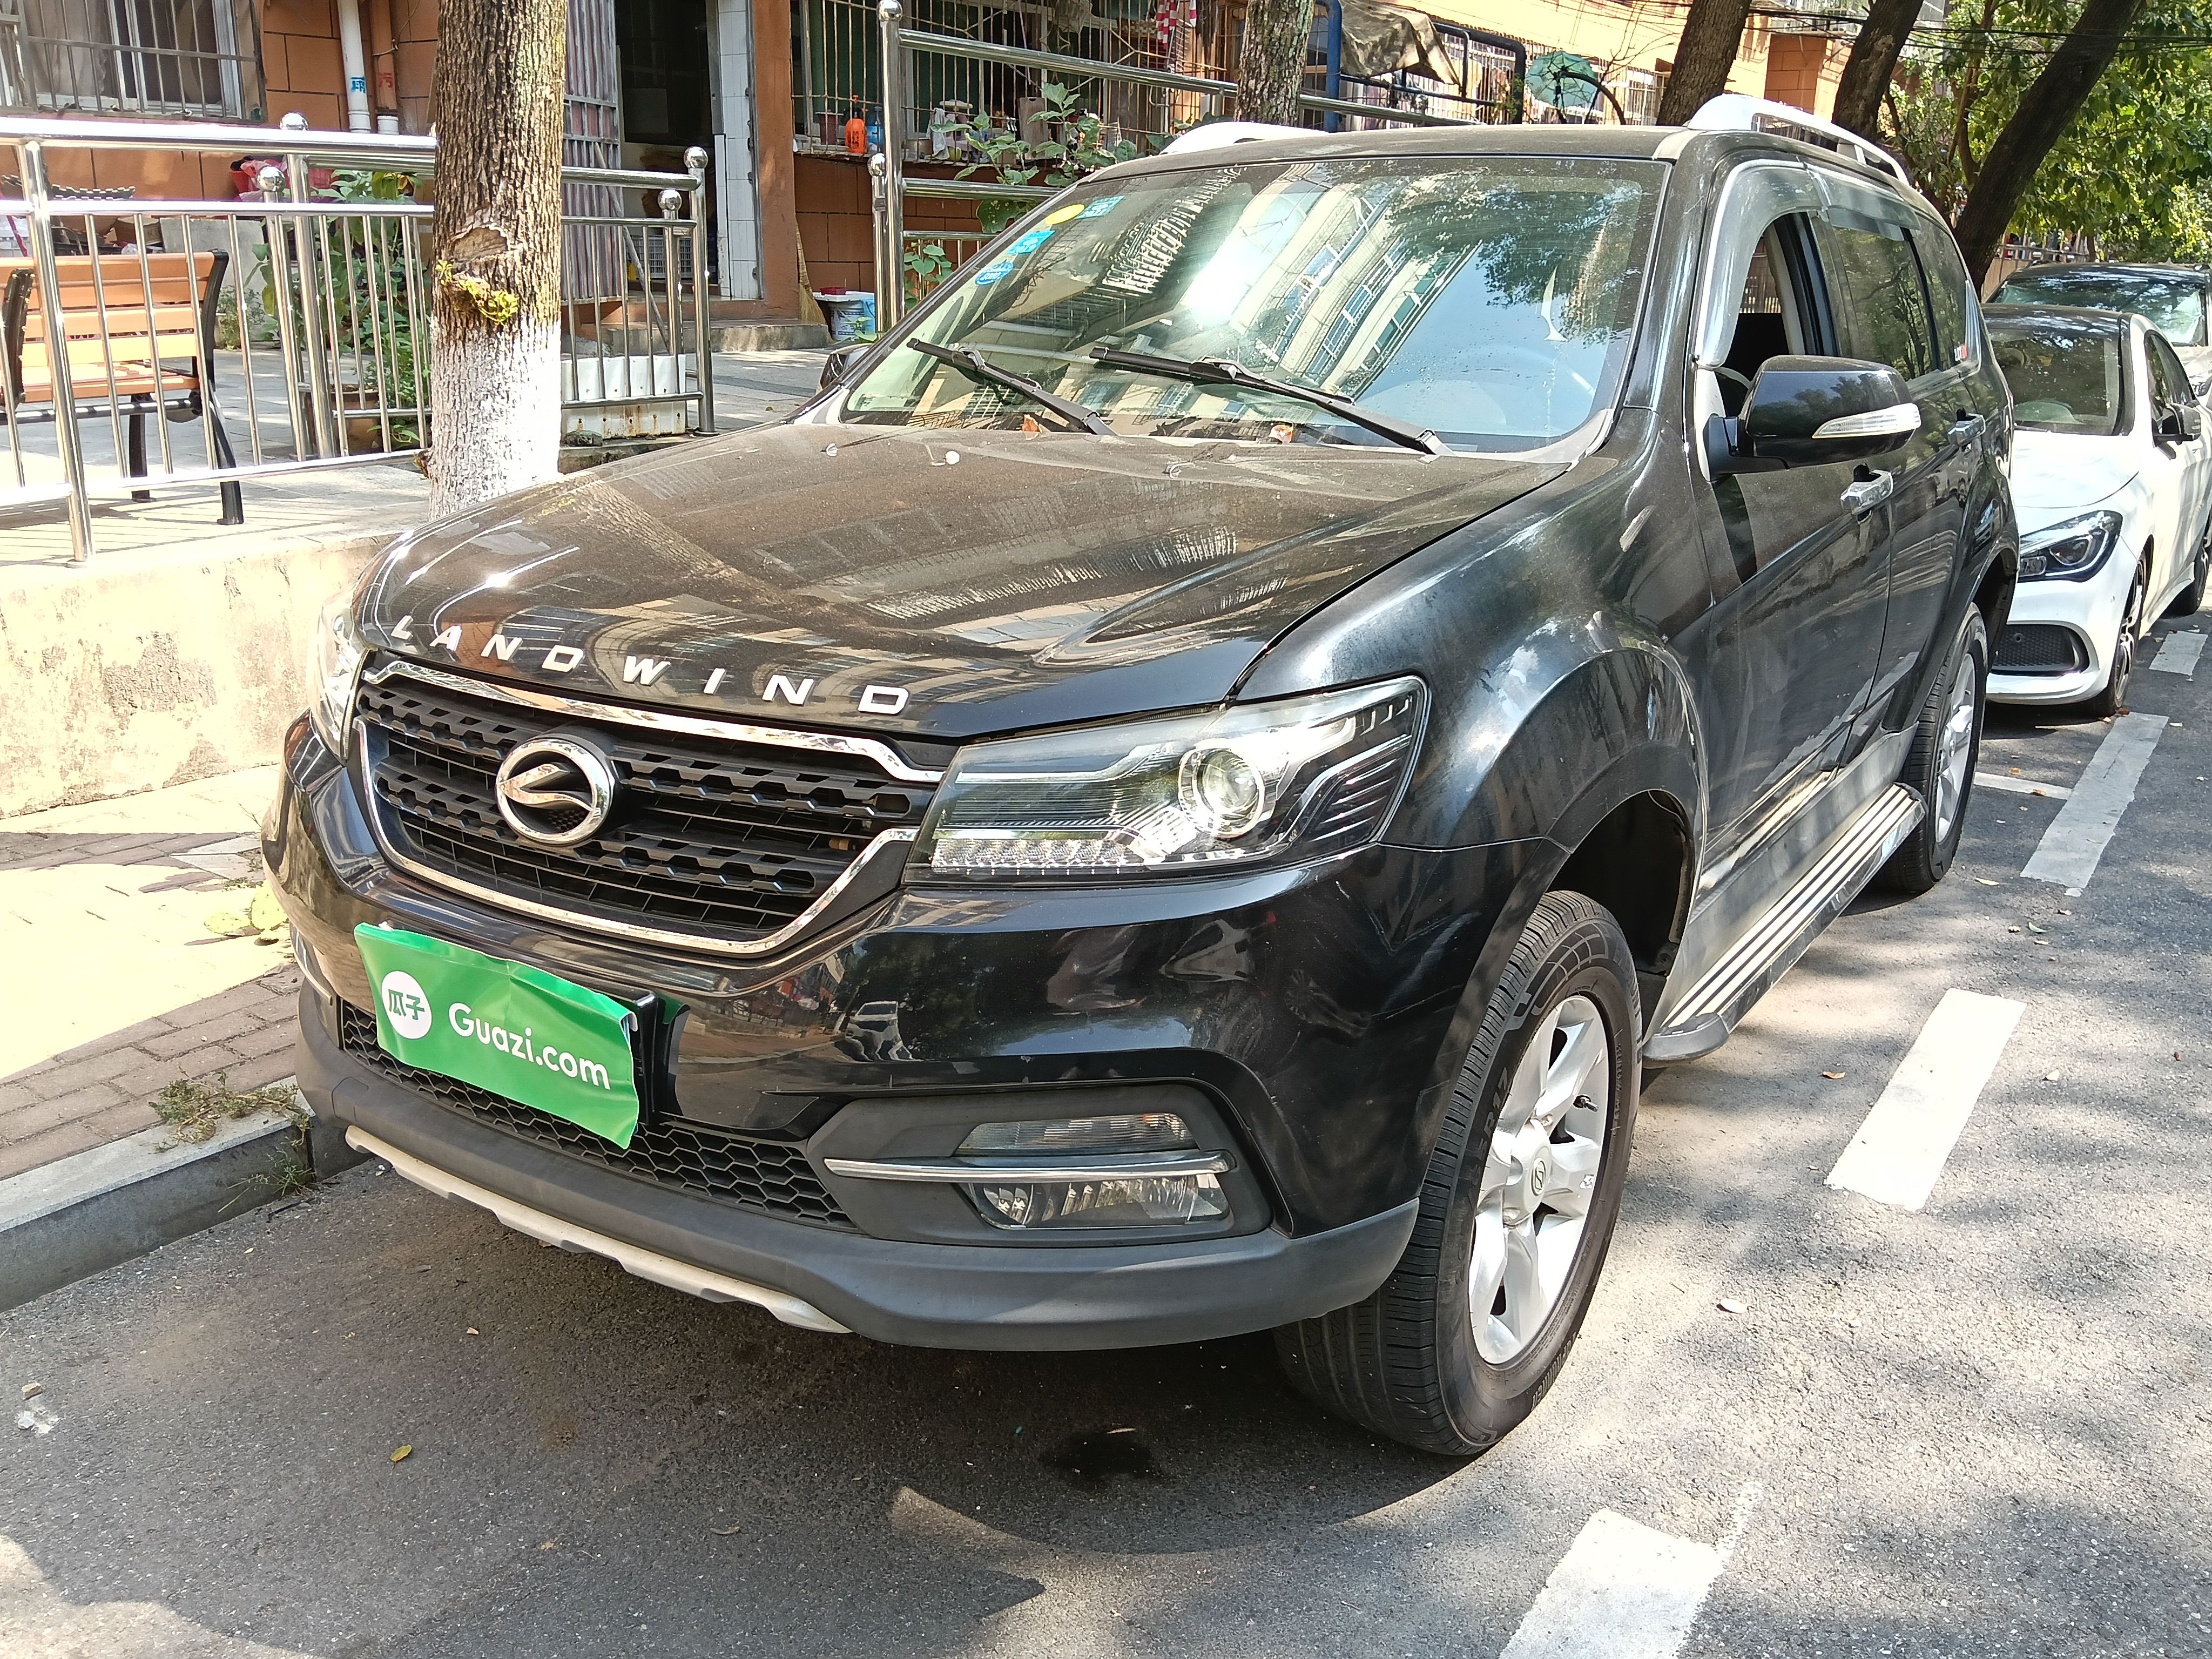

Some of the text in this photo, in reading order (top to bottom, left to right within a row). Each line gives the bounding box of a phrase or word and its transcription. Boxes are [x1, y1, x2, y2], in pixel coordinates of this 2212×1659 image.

[393, 615, 912, 715] LANDWIND
[388, 989, 425, 1020] 瓜子
[449, 1002, 611, 1090] Guazi.com
